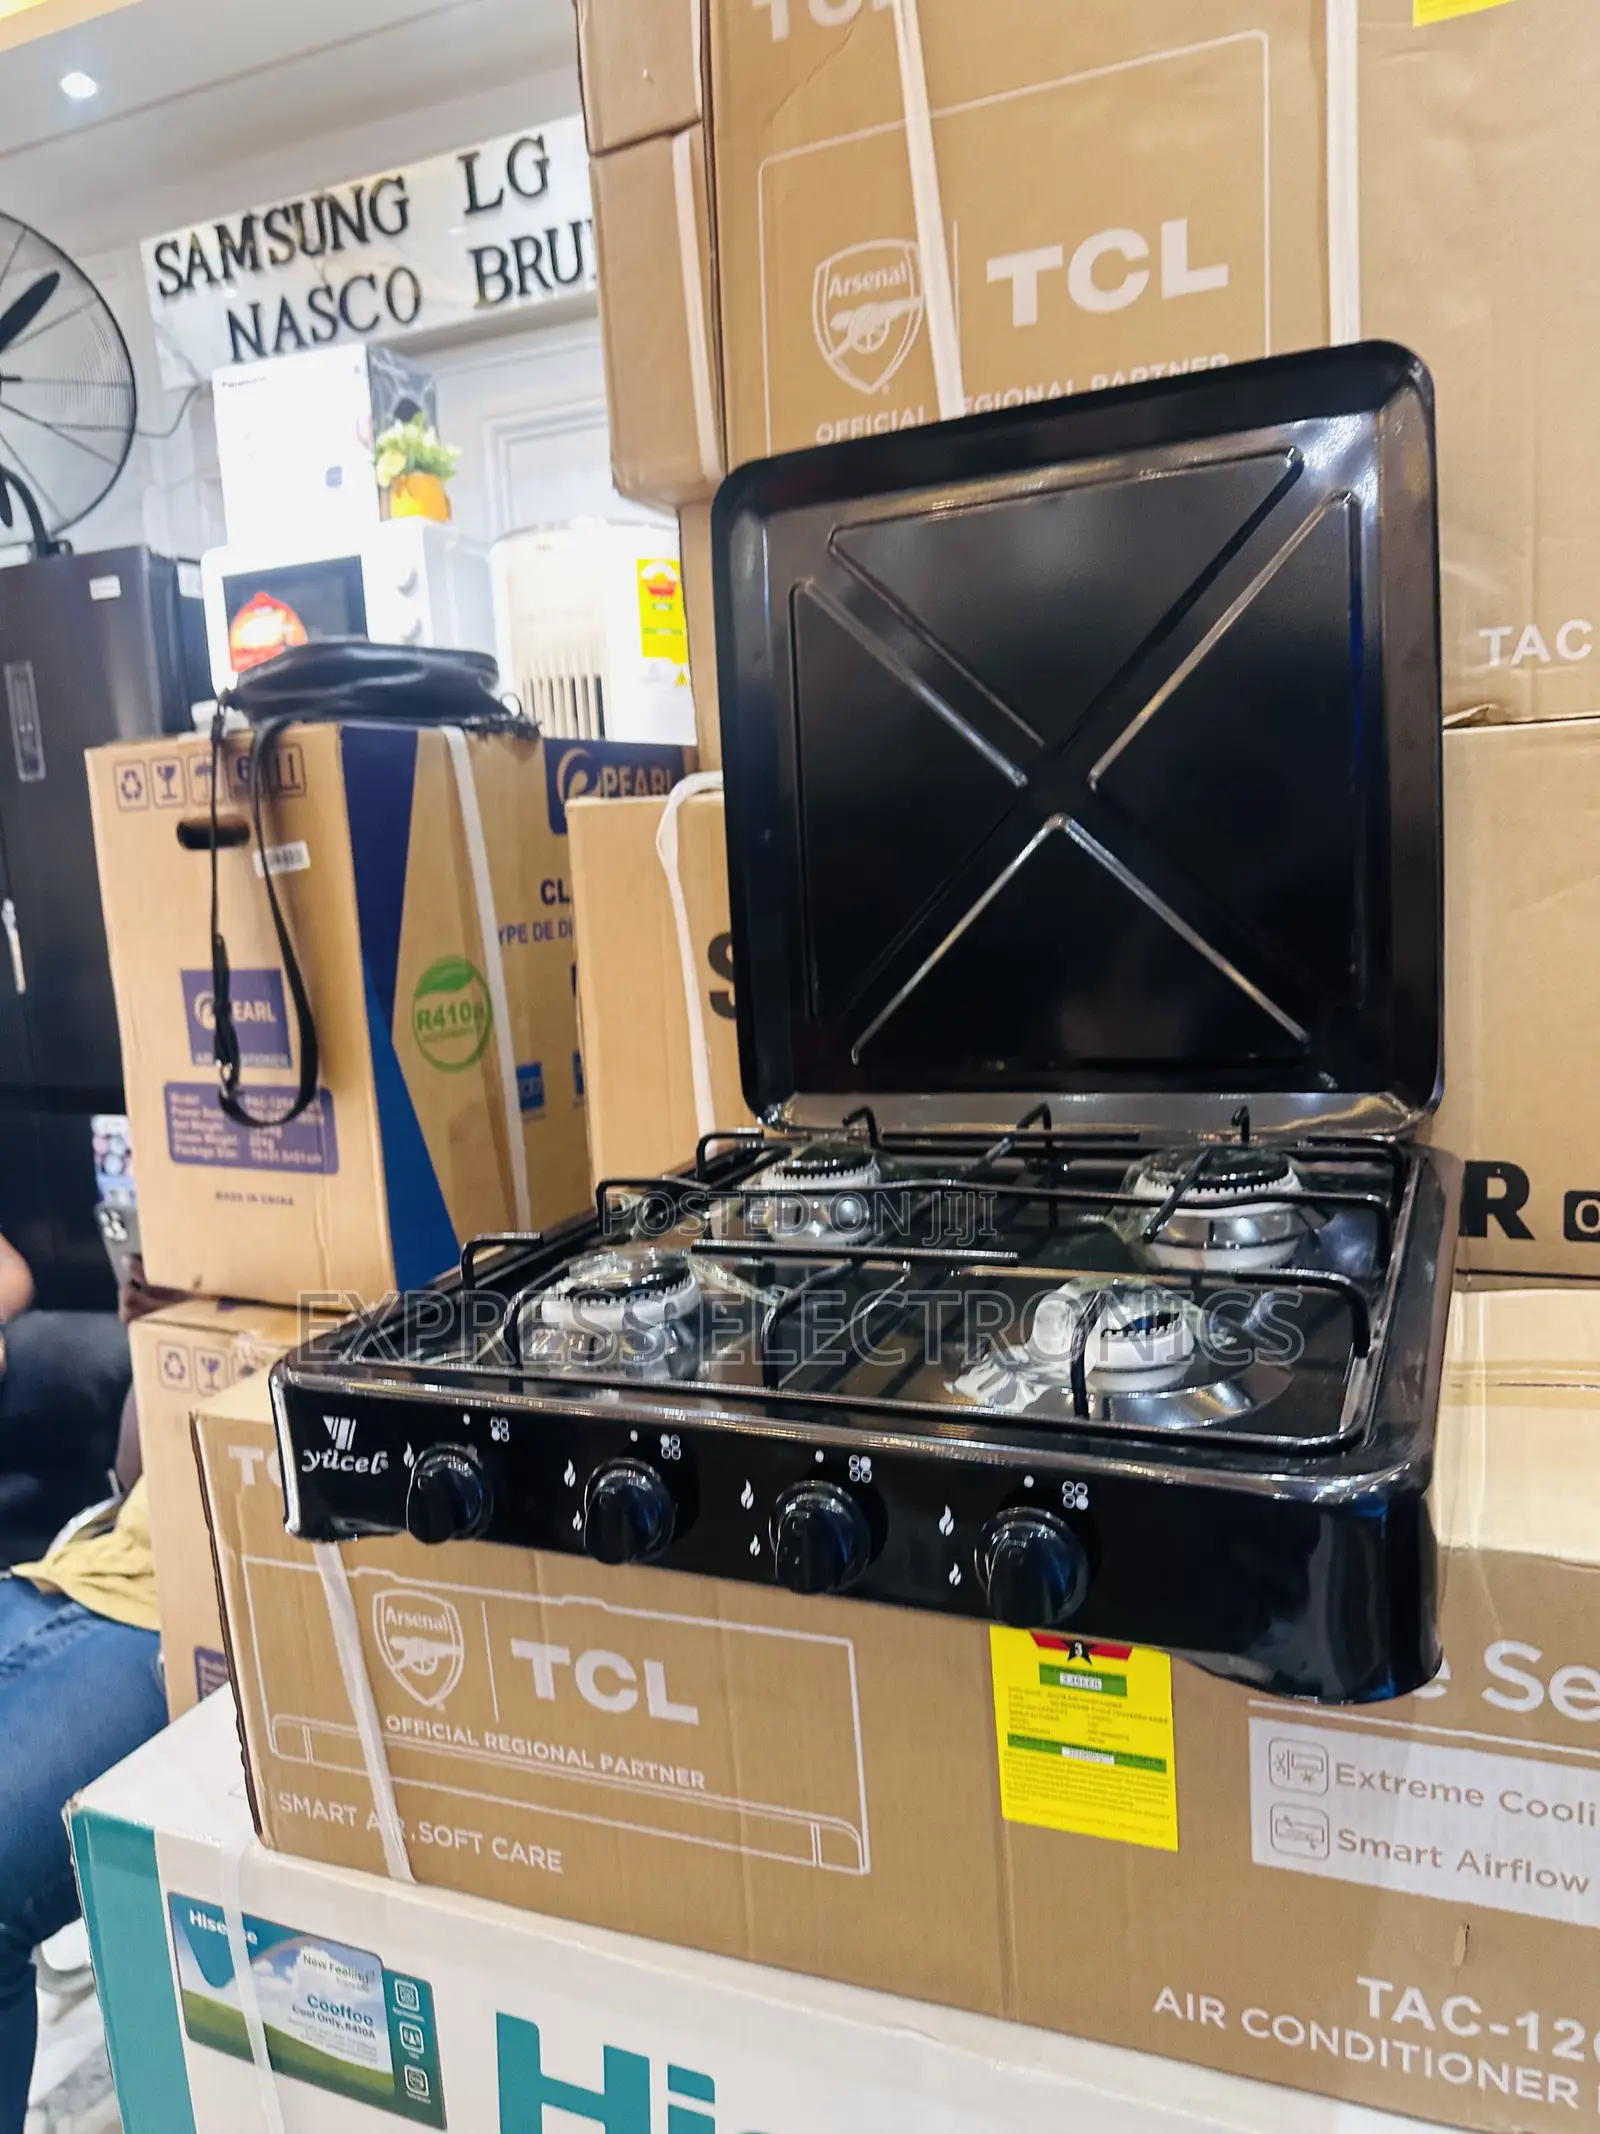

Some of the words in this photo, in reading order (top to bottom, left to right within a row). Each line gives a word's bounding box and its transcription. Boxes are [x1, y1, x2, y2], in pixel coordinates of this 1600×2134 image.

[154, 175, 410, 299] SAMSUNG
[458, 134, 551, 216] LG
[226, 267, 422, 363] NASCO
[468, 219, 596, 309] BRU
[829, 261, 908, 299] Arsenal
[986, 218, 1229, 328] TCL
[815, 405, 926, 446] OFFICIAL
[232, 1001, 277, 1024] EARL
[385, 1604, 449, 1634] Arsenal
[510, 1637, 699, 1726] TCL
[386, 1713, 480, 1748] OFFICIAL
[484, 1731, 596, 1770] REGIONAL
[600, 1753, 706, 1791] PARTNER
[1335, 1762, 1485, 1808] Extreme
[279, 1791, 357, 1827] SMART
[492, 1837, 564, 1874] CARE
[1337, 1828, 1443, 1869] Smart
[1456, 1849, 1590, 1895] Airflow
[189, 1907, 258, 1947] Hisee
[1152, 1986, 1227, 2029] AIR
[1241, 2007, 1580, 2110] CONDITIONER
[1356, 1975, 1600, 2063] TAC-12
